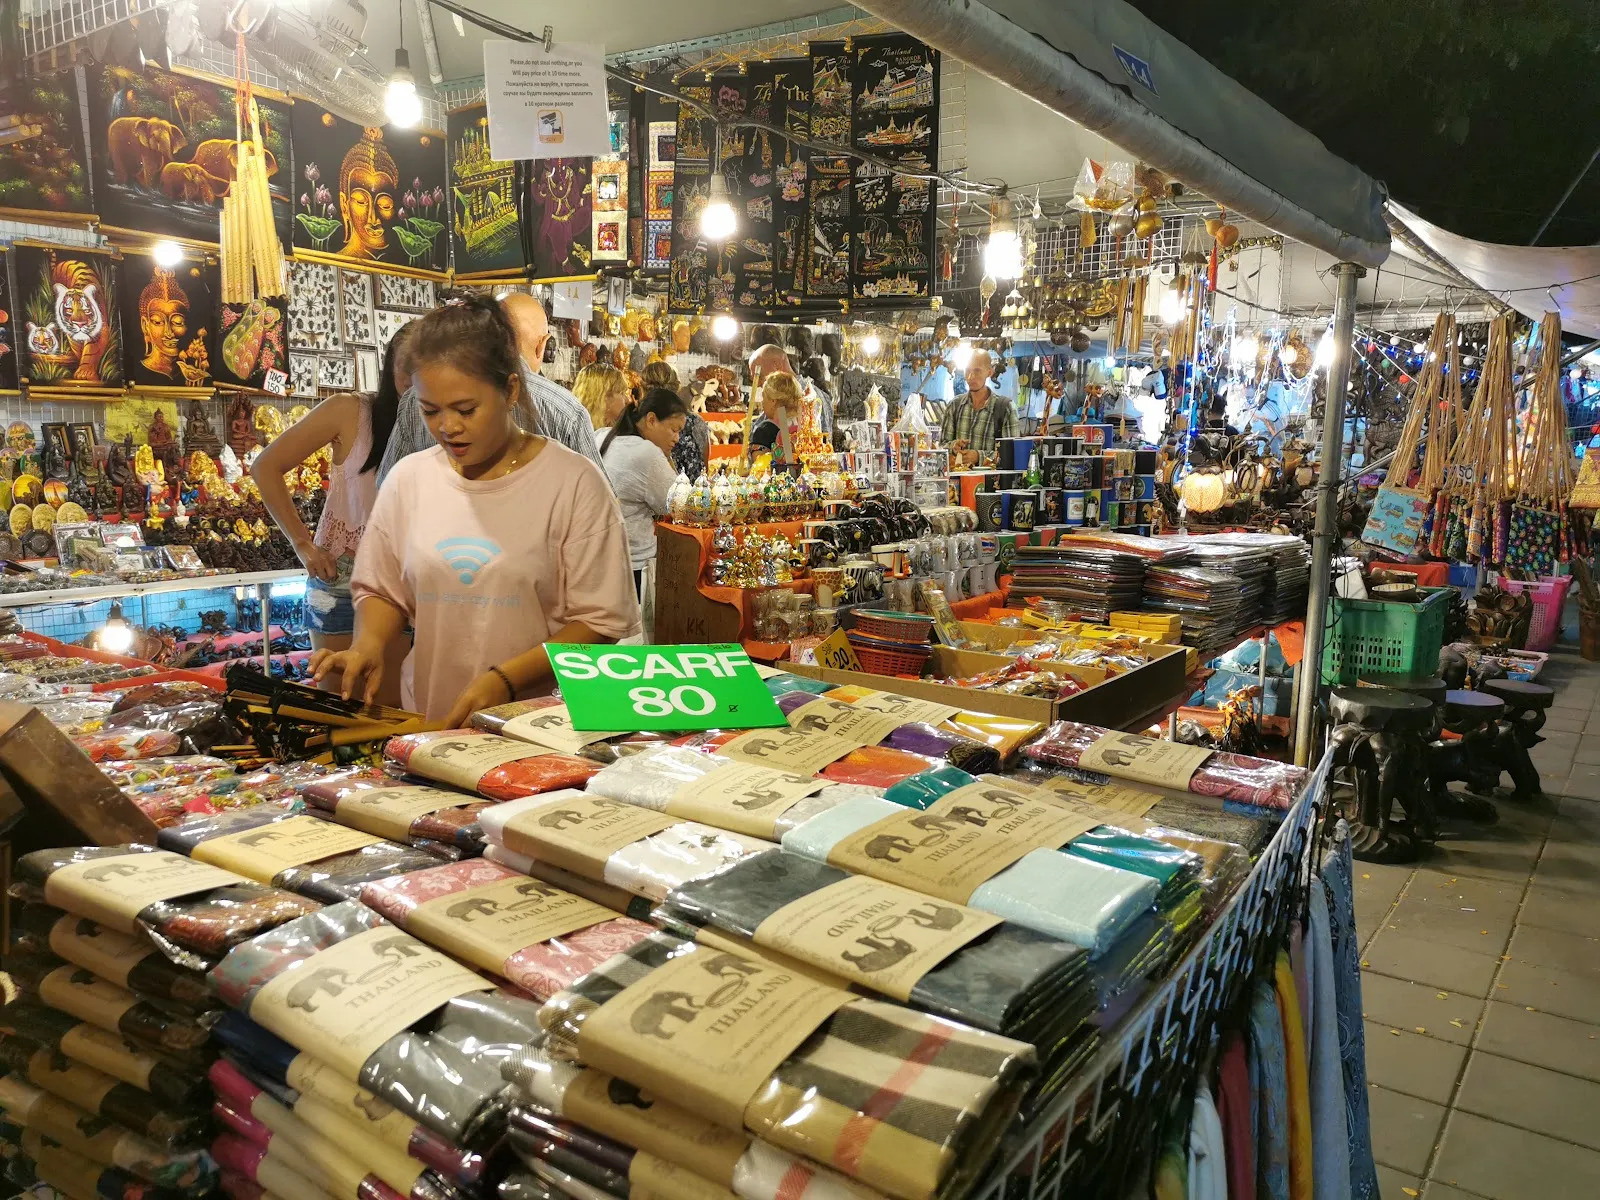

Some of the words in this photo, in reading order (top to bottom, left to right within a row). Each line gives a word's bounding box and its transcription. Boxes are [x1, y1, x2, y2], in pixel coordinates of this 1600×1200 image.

[881, 46, 913, 56] Thailand
[267, 381, 280, 394] 150
[687, 617, 706, 636] KK
[554, 651, 752, 680] SCARF
[628, 684, 717, 717] 80
[996, 806, 1047, 835] THAILAND
[924, 831, 982, 862] THAILAND
[499, 897, 579, 925] THAILAND
[827, 899, 898, 938] THAILAND
[345, 959, 443, 1009] THAILAND
[705, 973, 793, 1035] THAILAND
